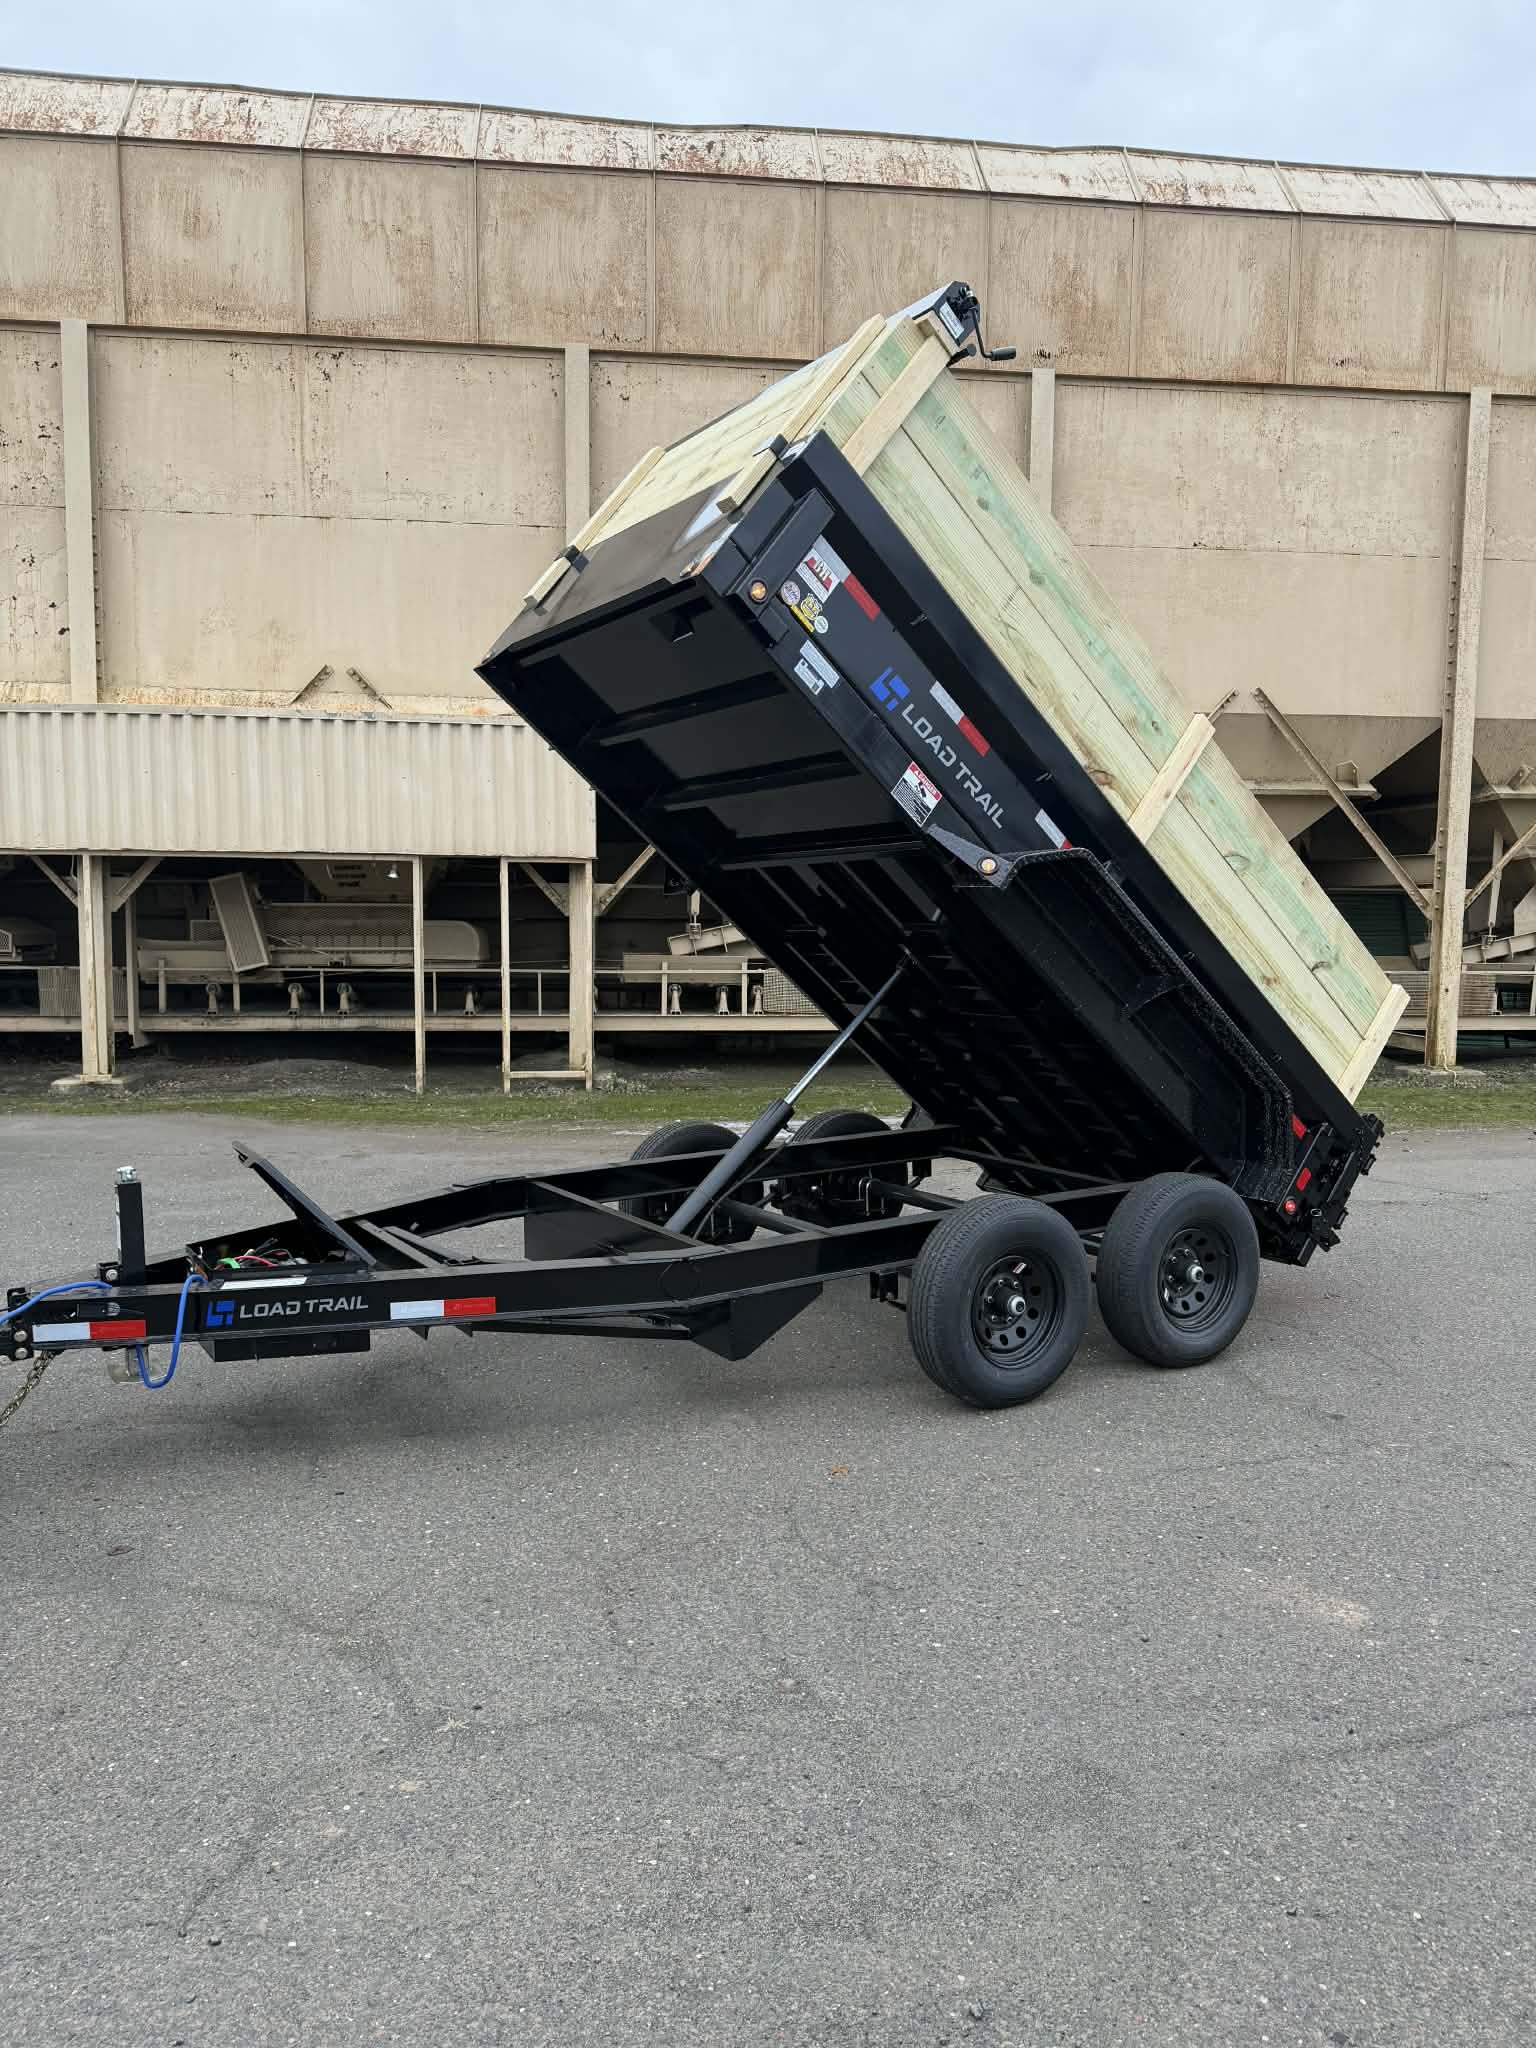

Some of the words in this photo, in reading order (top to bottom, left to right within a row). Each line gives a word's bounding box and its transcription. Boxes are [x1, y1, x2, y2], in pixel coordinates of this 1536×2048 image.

[902, 703, 957, 767] LOAD
[955, 761, 1004, 829] TRAIL
[239, 1301, 301, 1319] LOAD
[305, 1295, 369, 1313] TRAIL
